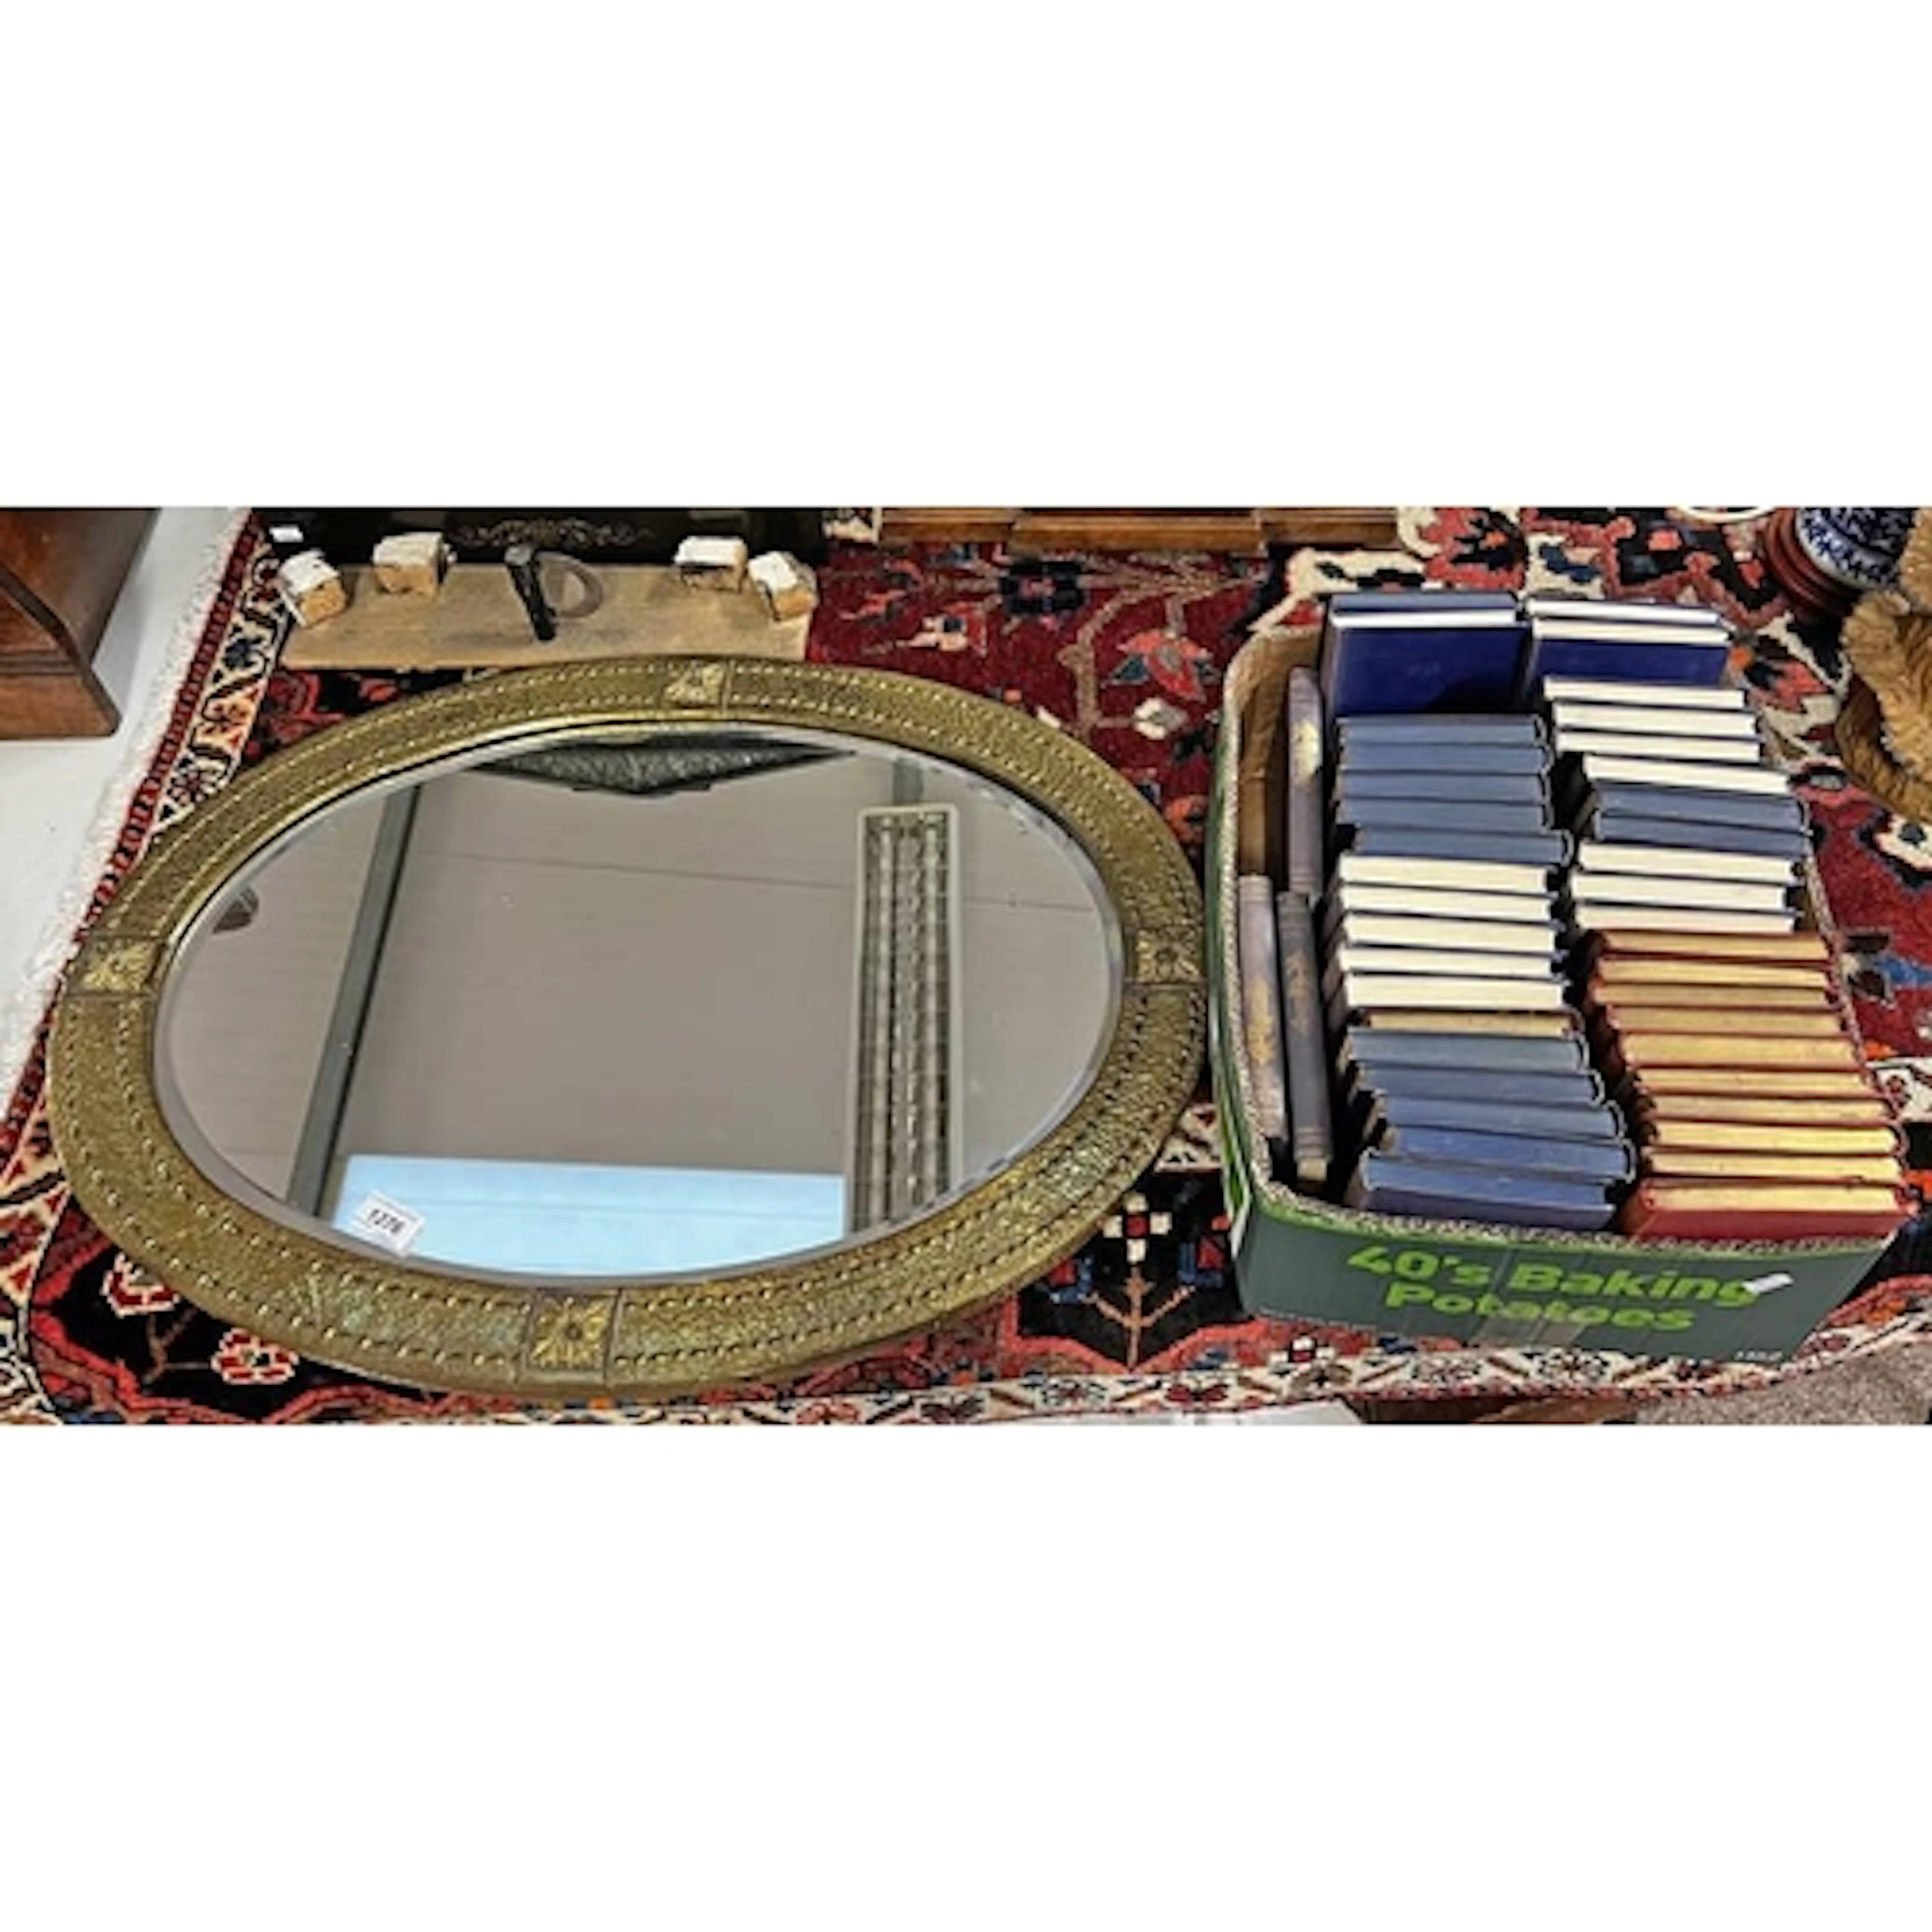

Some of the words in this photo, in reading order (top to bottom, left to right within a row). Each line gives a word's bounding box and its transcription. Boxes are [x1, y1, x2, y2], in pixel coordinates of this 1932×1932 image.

[1347, 1245, 1492, 1284] 40's
[1509, 1263, 1757, 1307] Baking
[1386, 1281, 1697, 1330] Potatoes
